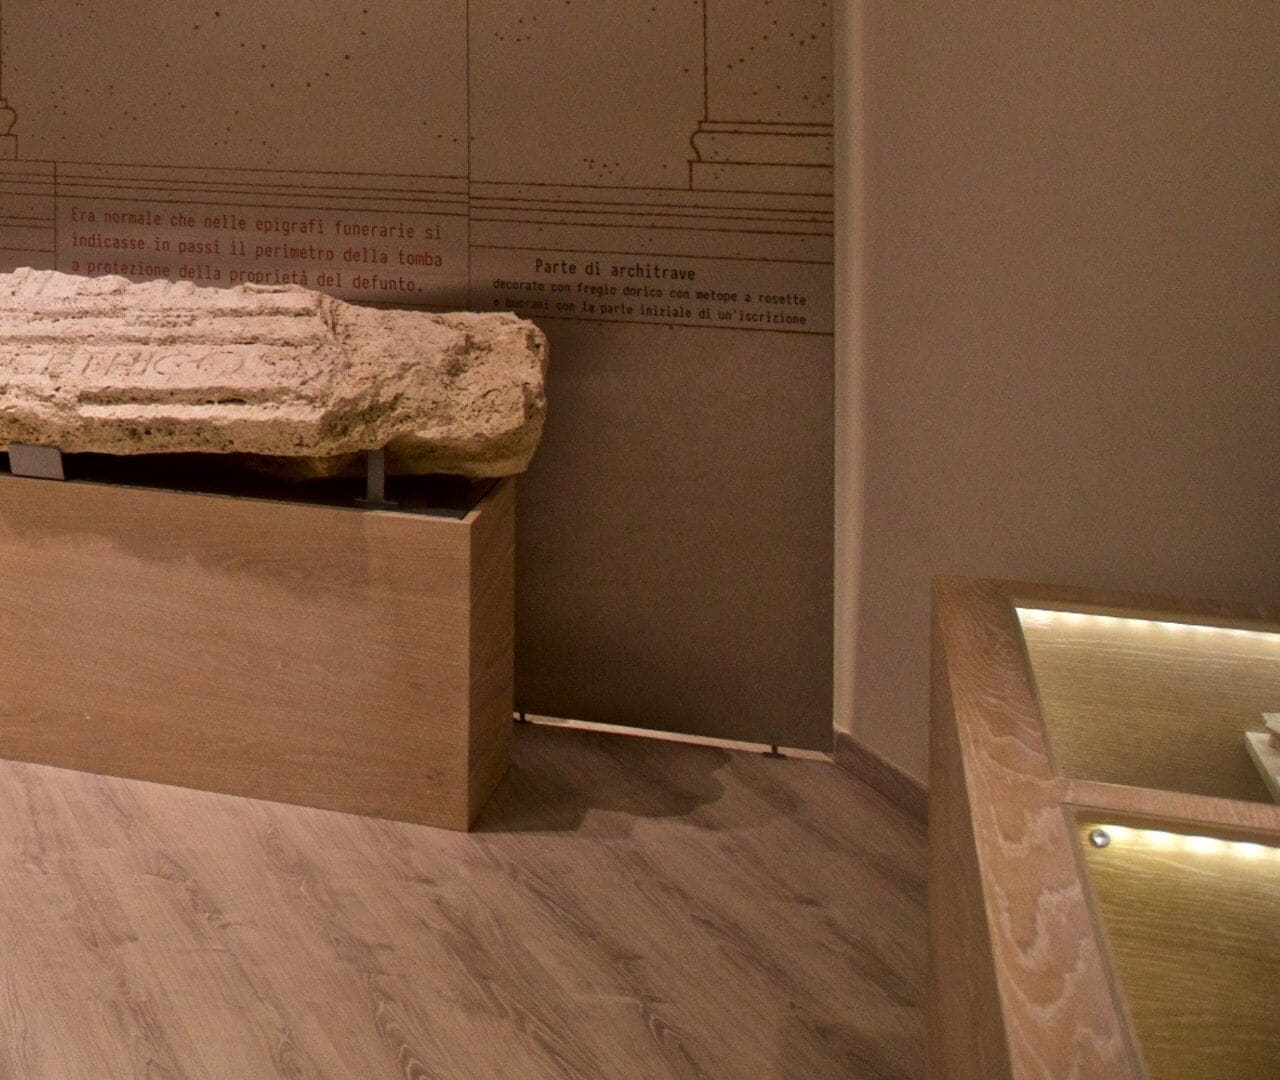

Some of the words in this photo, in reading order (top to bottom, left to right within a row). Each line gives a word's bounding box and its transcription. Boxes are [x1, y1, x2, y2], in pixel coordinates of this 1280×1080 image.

[70, 206, 96, 222] Era
[104, 211, 161, 226] normale
[170, 213, 194, 228] che
[204, 214, 246, 230] nelle
[255, 217, 324, 236] epigrafi
[335, 220, 415, 239] funerarie
[424, 224, 442, 241] si
[71, 233, 145, 251] indicasse
[155, 236, 170, 252] in
[178, 239, 221, 255] passi
[231, 241, 246, 257] il
[255, 243, 335, 261] perimetro
[343, 248, 388, 264] della
[398, 250, 443, 268] tomba
[71, 261, 80, 273] a
[87, 261, 170, 278] protezione
[178, 264, 222, 281] della
[229, 268, 308, 287] proprietà
[316, 273, 342, 288] del
[352, 275, 423, 293] defunto.
[535, 258, 577, 274] Parte
[585, 261, 601, 276] di
[611, 263, 696, 280] architrave
[492, 278, 545, 292] decorato
[551, 282, 571, 293] con
[577, 282, 617, 297] fregio
[622, 286, 663, 298] dorico
[669, 289, 690, 300] con
[695, 290, 738, 303] metope
[758, 293, 807, 306] rosette
